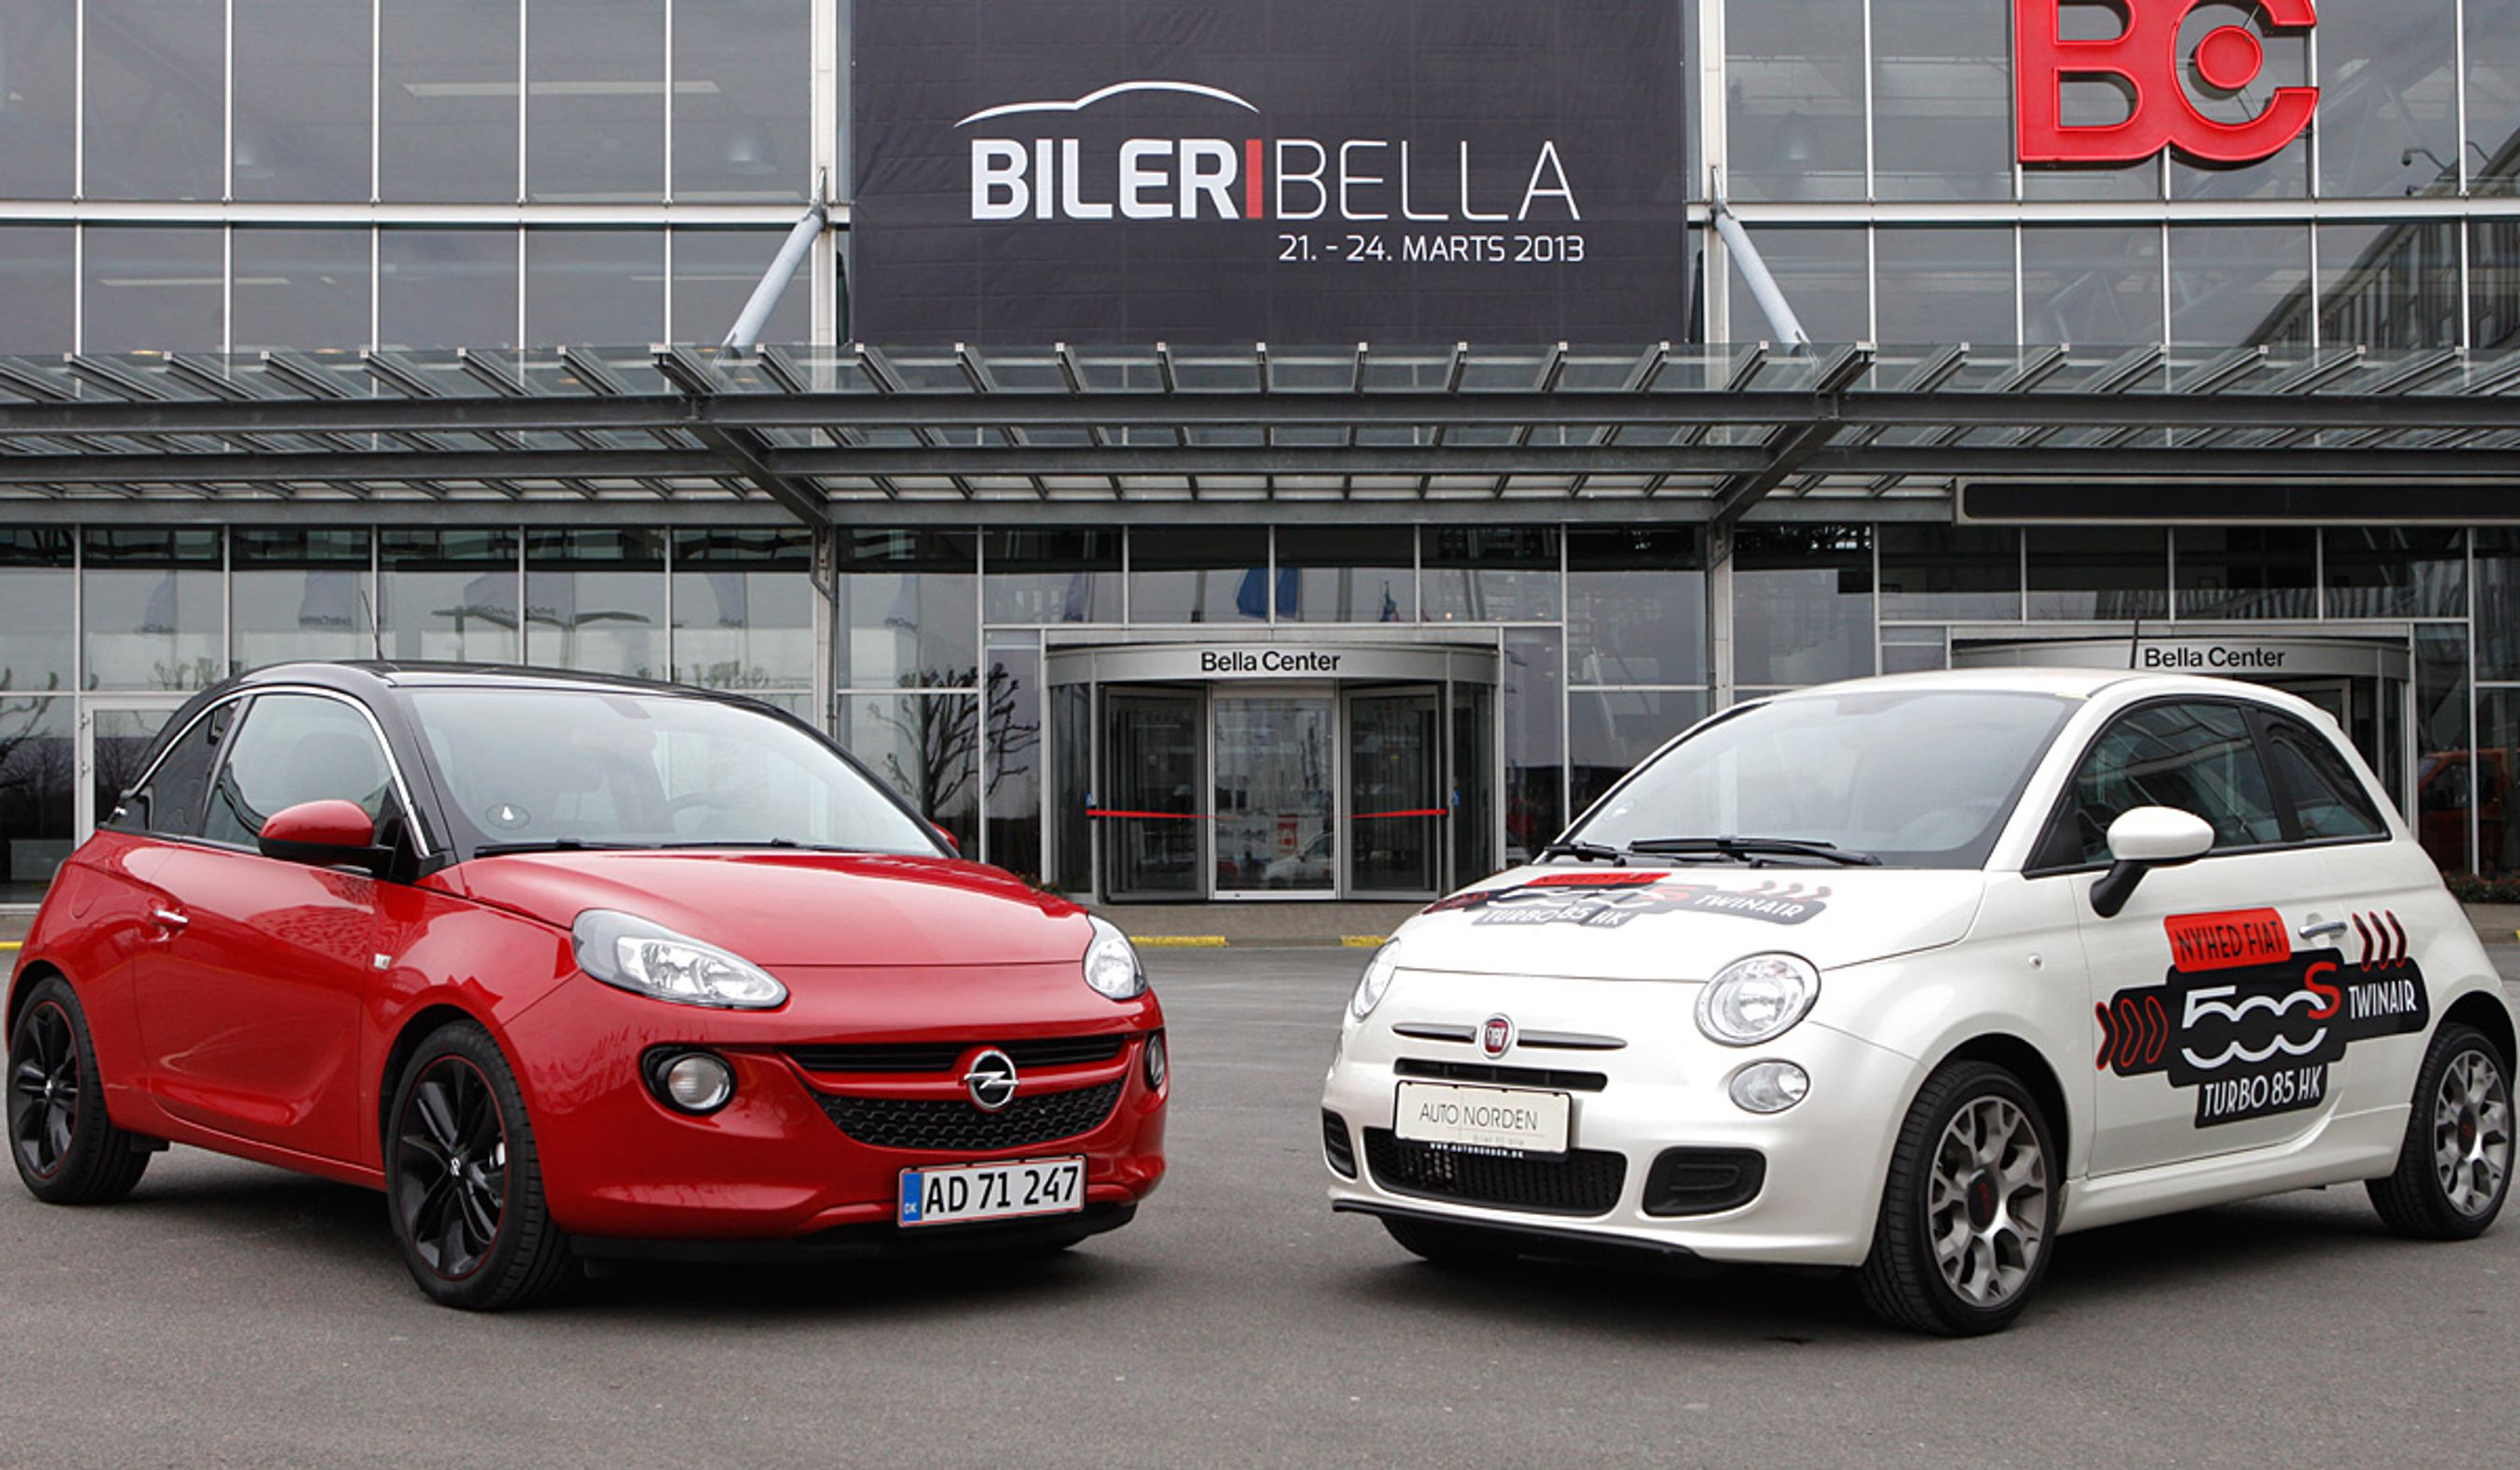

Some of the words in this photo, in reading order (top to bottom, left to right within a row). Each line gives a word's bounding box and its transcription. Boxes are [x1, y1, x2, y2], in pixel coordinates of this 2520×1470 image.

[1278, 235, 1317, 262] 21.
[1346, 235, 1392, 262] 24.
[1403, 235, 1505, 262] MARTS
[1514, 235, 1585, 262] 2013
[1201, 651, 1258, 671] Bella
[1262, 651, 1341, 671] Center
[2144, 647, 2202, 668] Bella
[2208, 647, 2285, 668] Center
[1483, 907, 1558, 923] TURBO
[1694, 893, 1806, 917] TWINAIR
[2175, 925, 2243, 963] NYHED
[2244, 920, 2282, 956] FIAT
[2348, 979, 2418, 1020] TWINAIR
[2204, 1074, 2268, 1117] TURBO
[2270, 1070, 2295, 1105] 85
[2297, 1064, 2324, 1102] HK
[1419, 1102, 1460, 1125] AUTO
[1462, 1106, 1539, 1131] NORDEN
[925, 1175, 968, 1214] AD
[978, 1172, 1011, 1209] 71
[1023, 1165, 1079, 1205] 247
